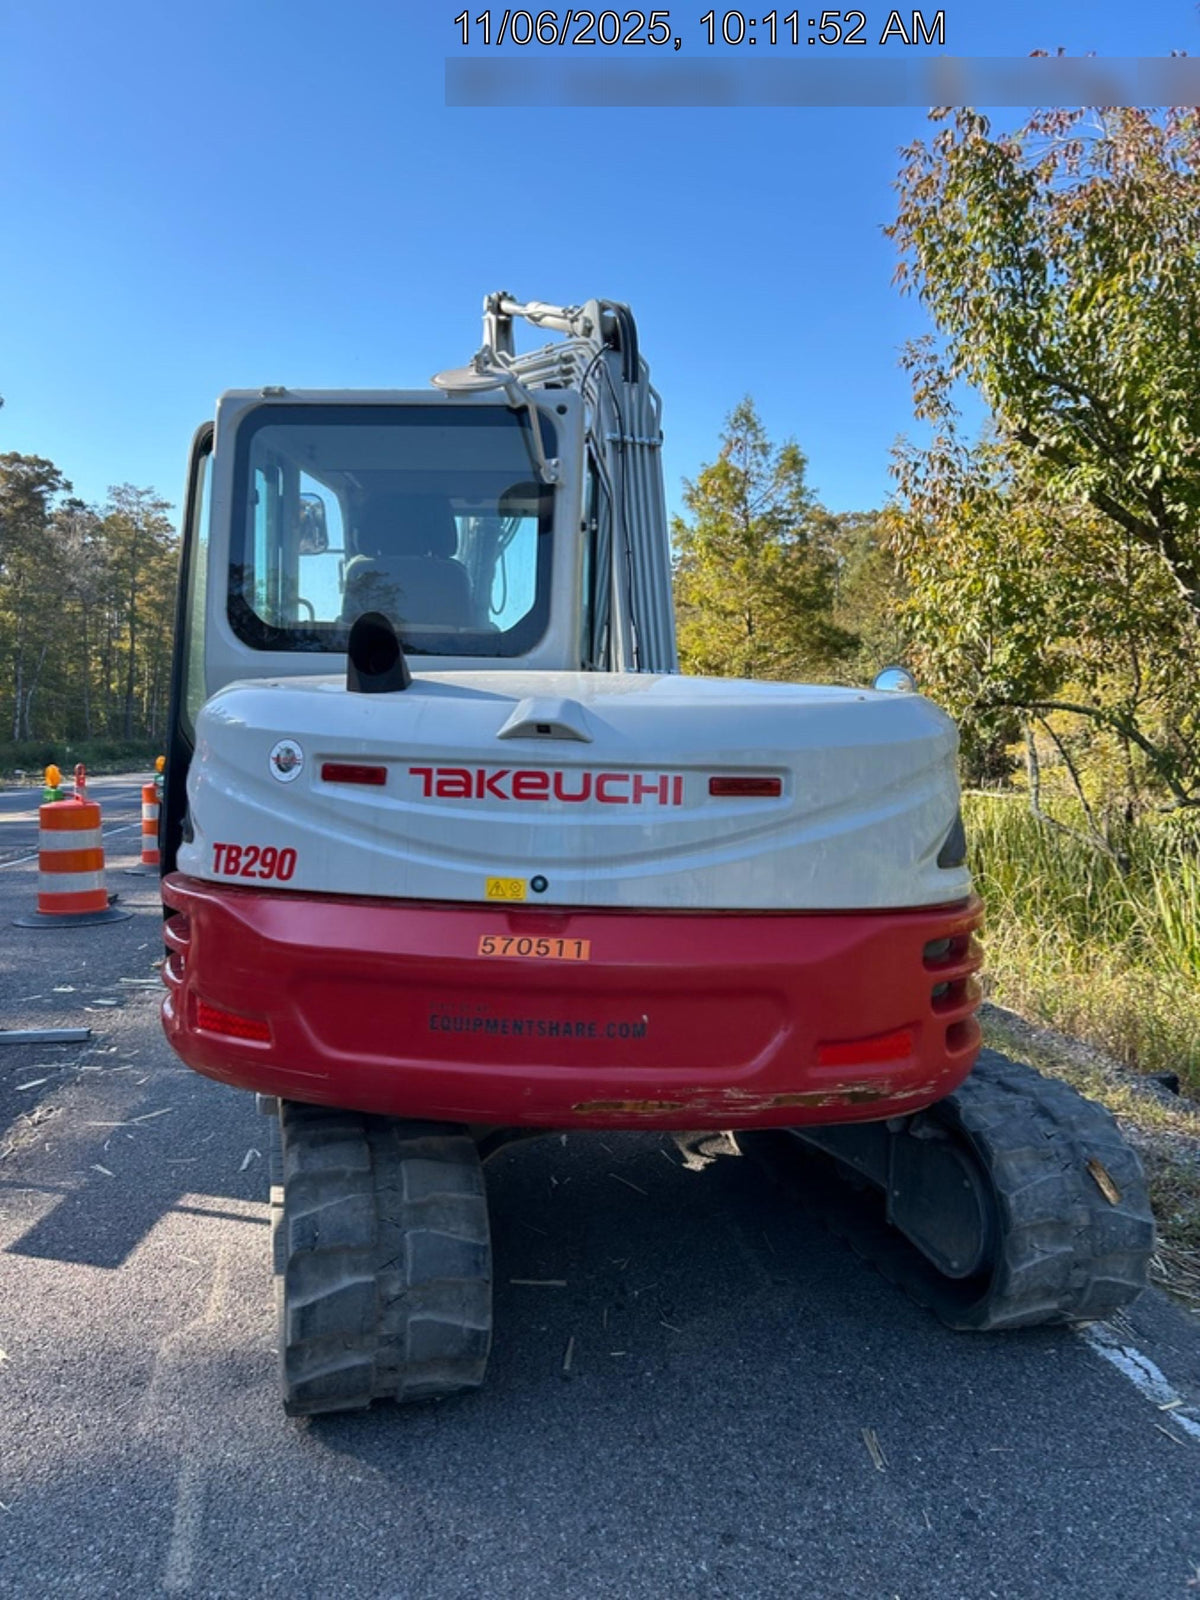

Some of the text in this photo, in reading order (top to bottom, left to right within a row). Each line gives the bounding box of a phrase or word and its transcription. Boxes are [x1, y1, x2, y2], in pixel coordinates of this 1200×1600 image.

[408, 767, 683, 805] TAKEUCHI
[213, 842, 297, 881] TB290
[481, 936, 582, 958] 570511
[429, 1014, 648, 1038] EQUIPMENTSHARE.COM
